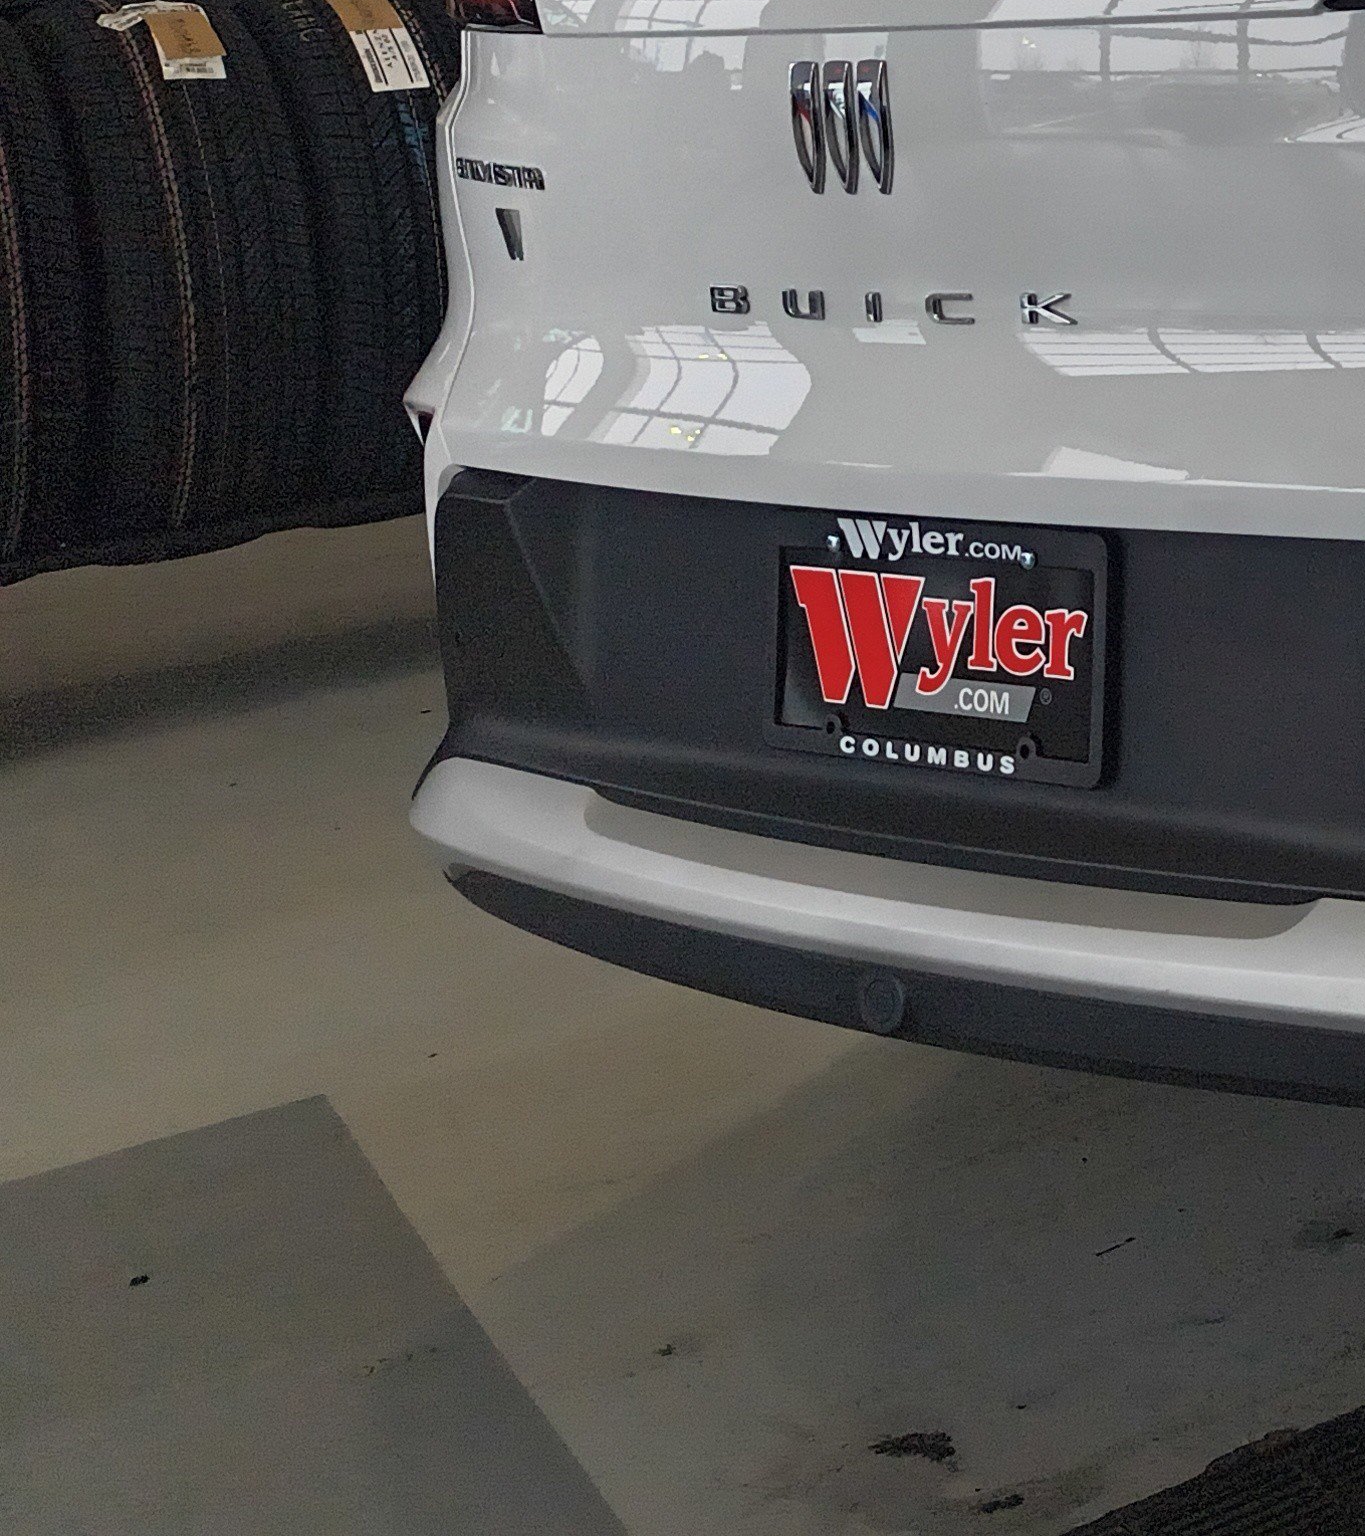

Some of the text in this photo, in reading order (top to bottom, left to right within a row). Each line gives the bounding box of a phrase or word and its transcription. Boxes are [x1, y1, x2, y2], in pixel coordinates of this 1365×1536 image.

[709, 284, 1079, 325] BUICK
[789, 565, 1088, 709] Wyler
[839, 735, 1015, 774] COLUMBUS
